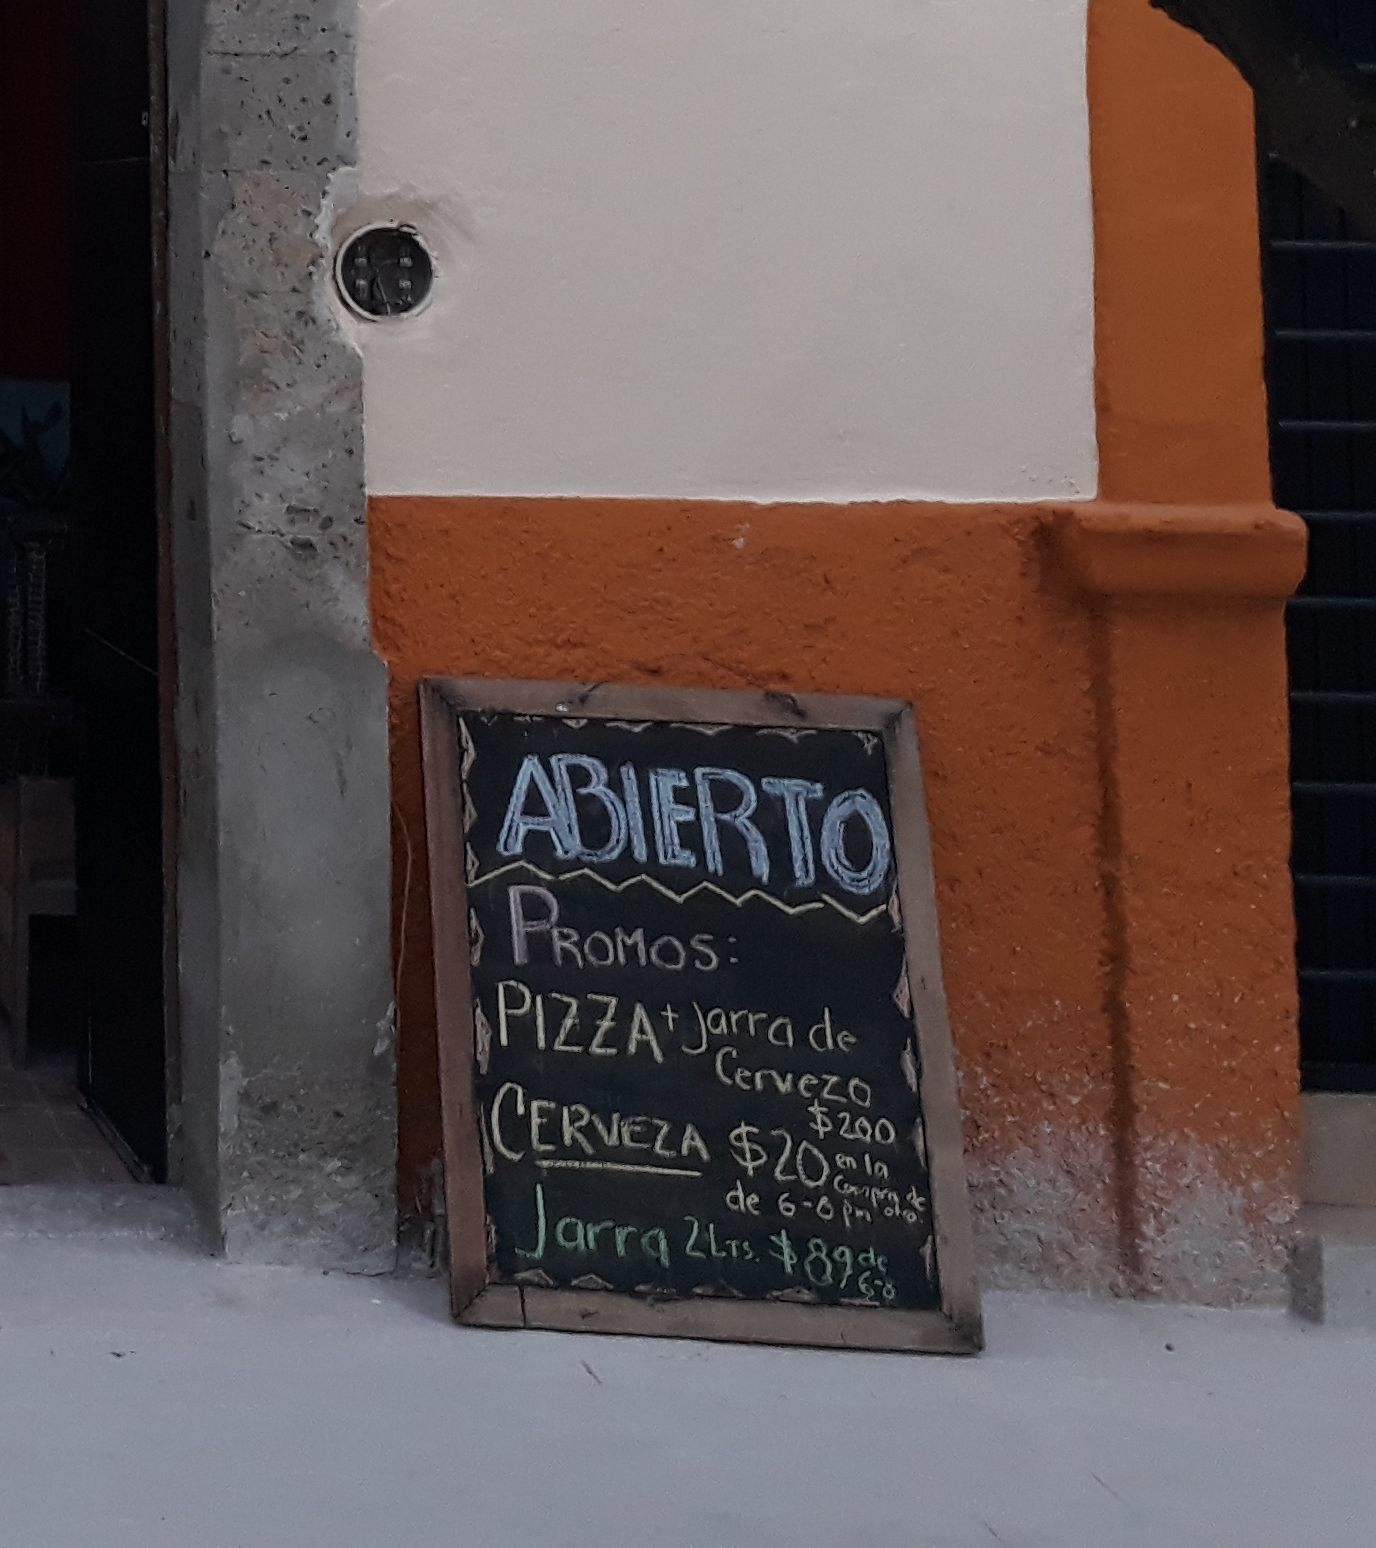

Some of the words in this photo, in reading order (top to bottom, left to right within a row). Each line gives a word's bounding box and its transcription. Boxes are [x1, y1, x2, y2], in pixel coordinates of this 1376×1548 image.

[495, 753, 890, 895] ABIERTO
[497, 979, 665, 1064] PIZZA
[659, 1002, 680, 1033] +
[808, 1005, 859, 1052] de
[491, 1080, 712, 1163] CERVEZA
[728, 1119, 831, 1189] $20
[514, 1183, 670, 1269] Jarra
[857, 1245, 889, 1275] de
[725, 1179, 762, 1216] de
